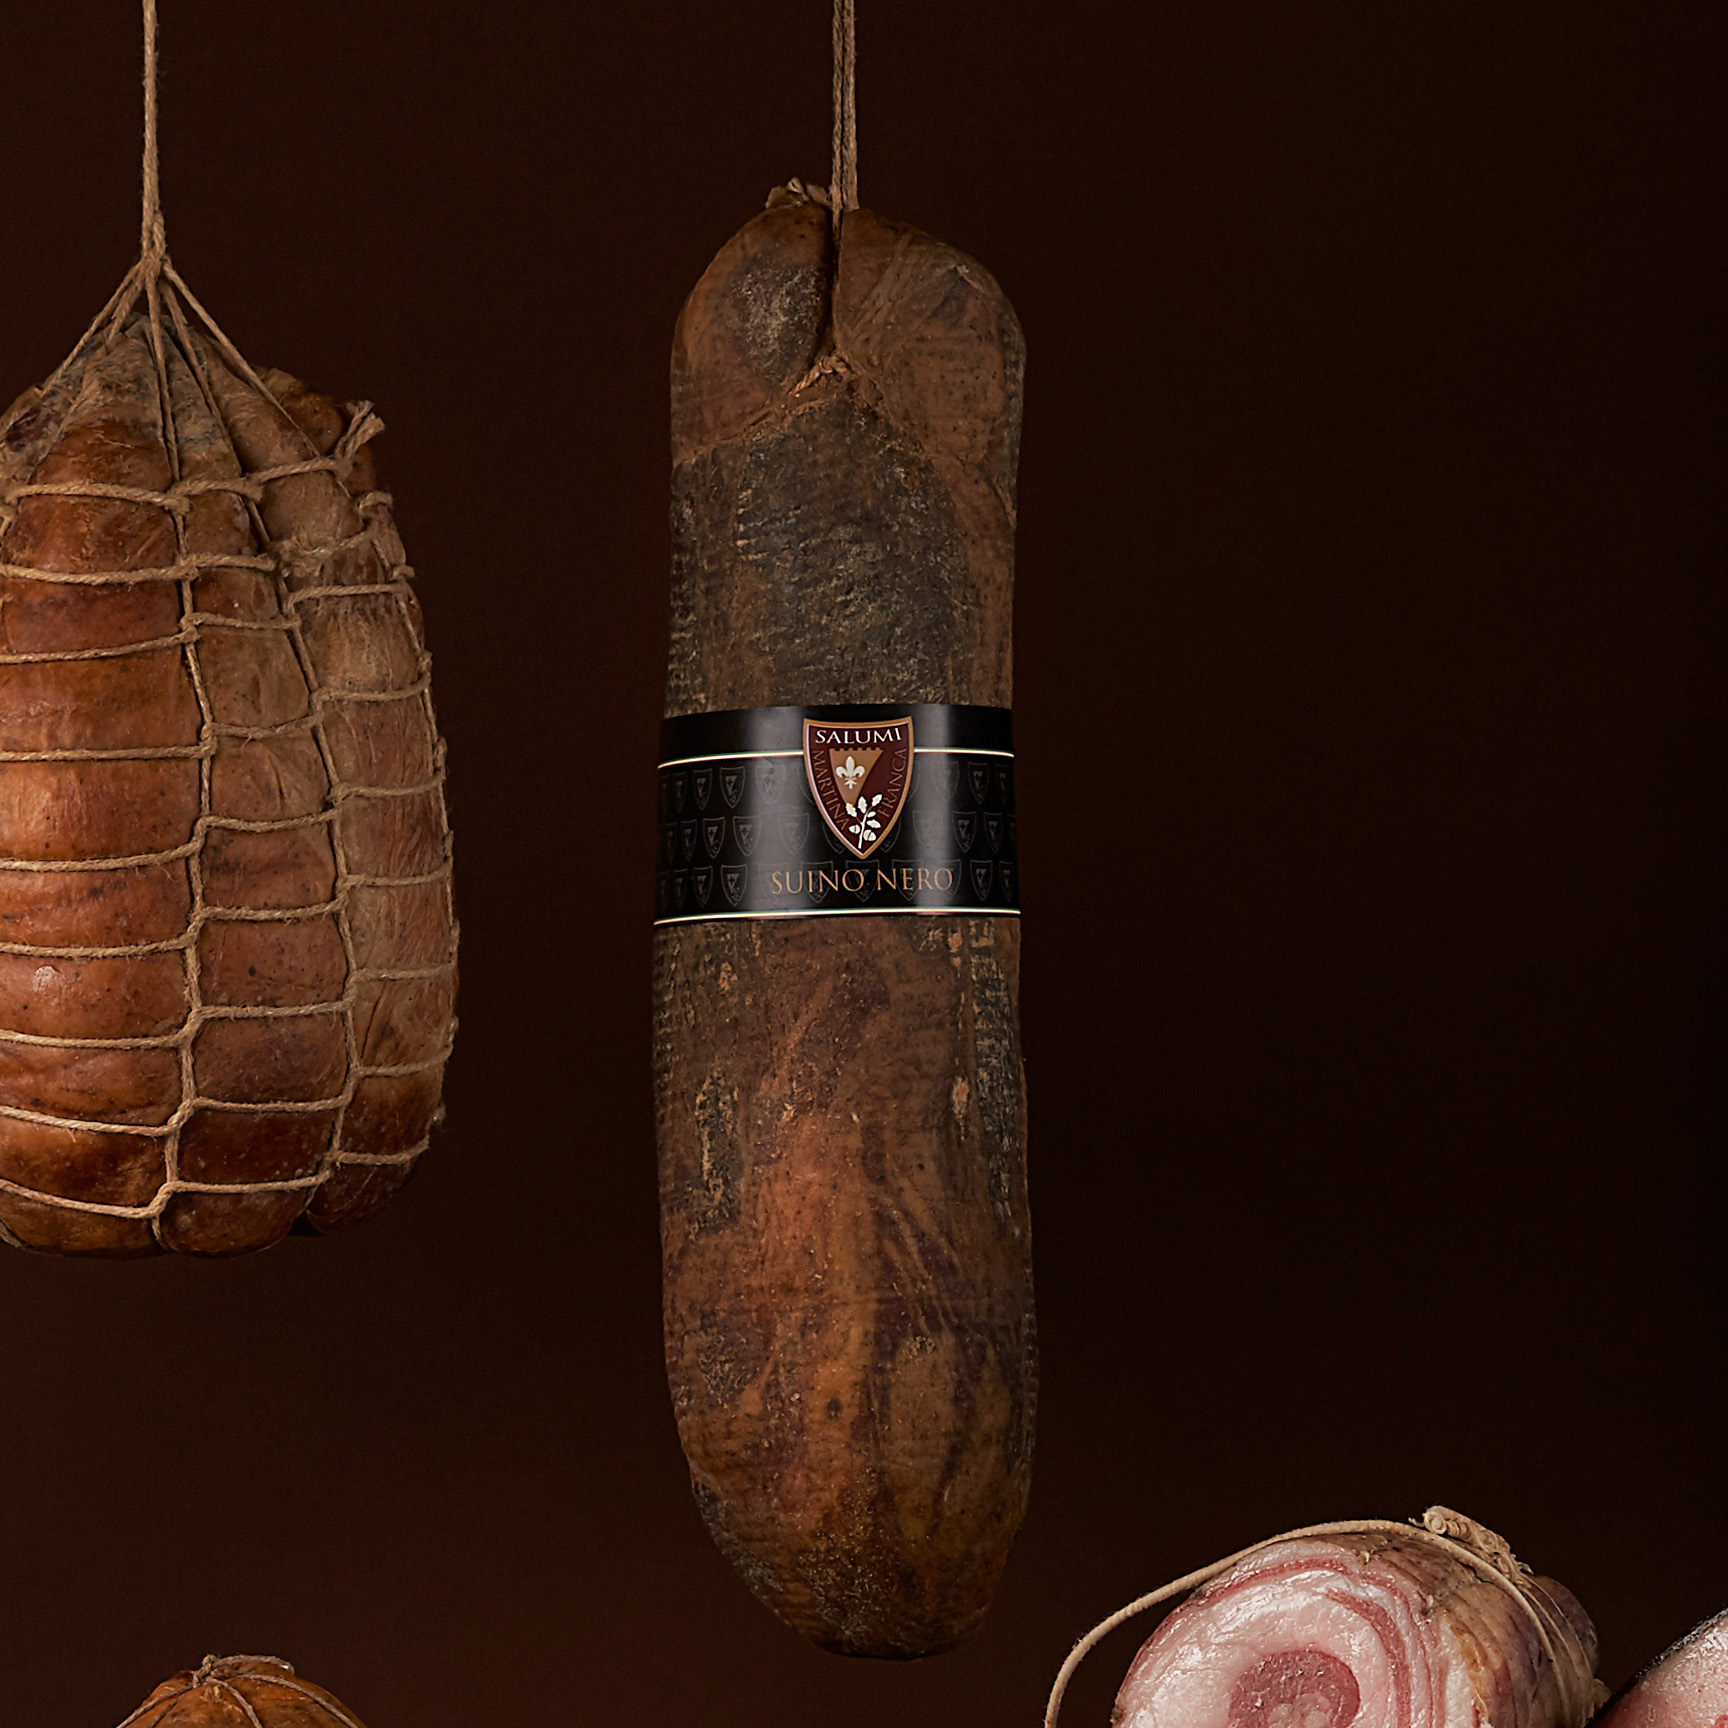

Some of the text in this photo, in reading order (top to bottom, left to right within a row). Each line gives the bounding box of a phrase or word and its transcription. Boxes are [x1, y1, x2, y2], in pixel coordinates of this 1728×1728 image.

[815, 727, 902, 744] SALUMI
[812, 748, 908, 831] MARTINA FRANCA
[771, 867, 953, 894] SUINO NERO
